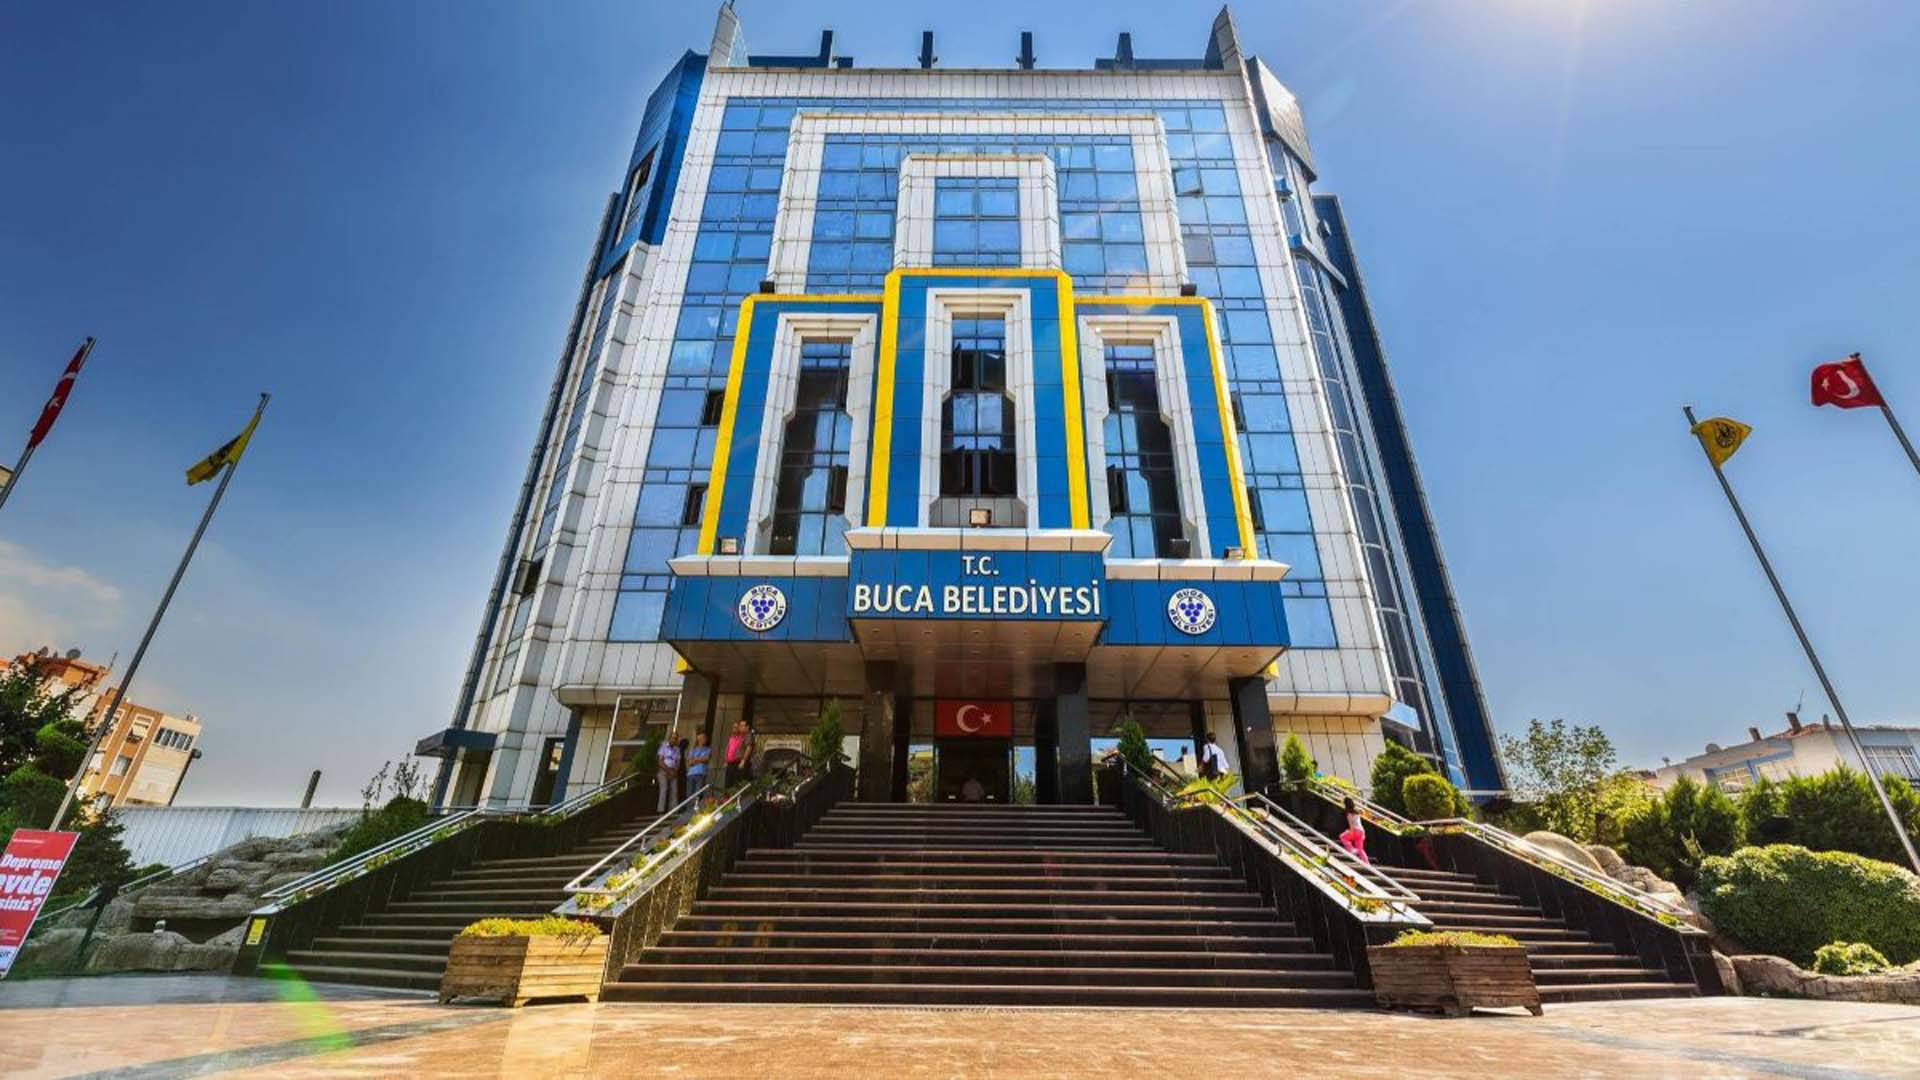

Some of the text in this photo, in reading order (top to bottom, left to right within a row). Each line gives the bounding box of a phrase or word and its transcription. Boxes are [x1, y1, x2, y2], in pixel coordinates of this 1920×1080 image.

[963, 556, 999, 576] T.C.
[853, 579, 1100, 615] BUCA BELEDİYESİ
